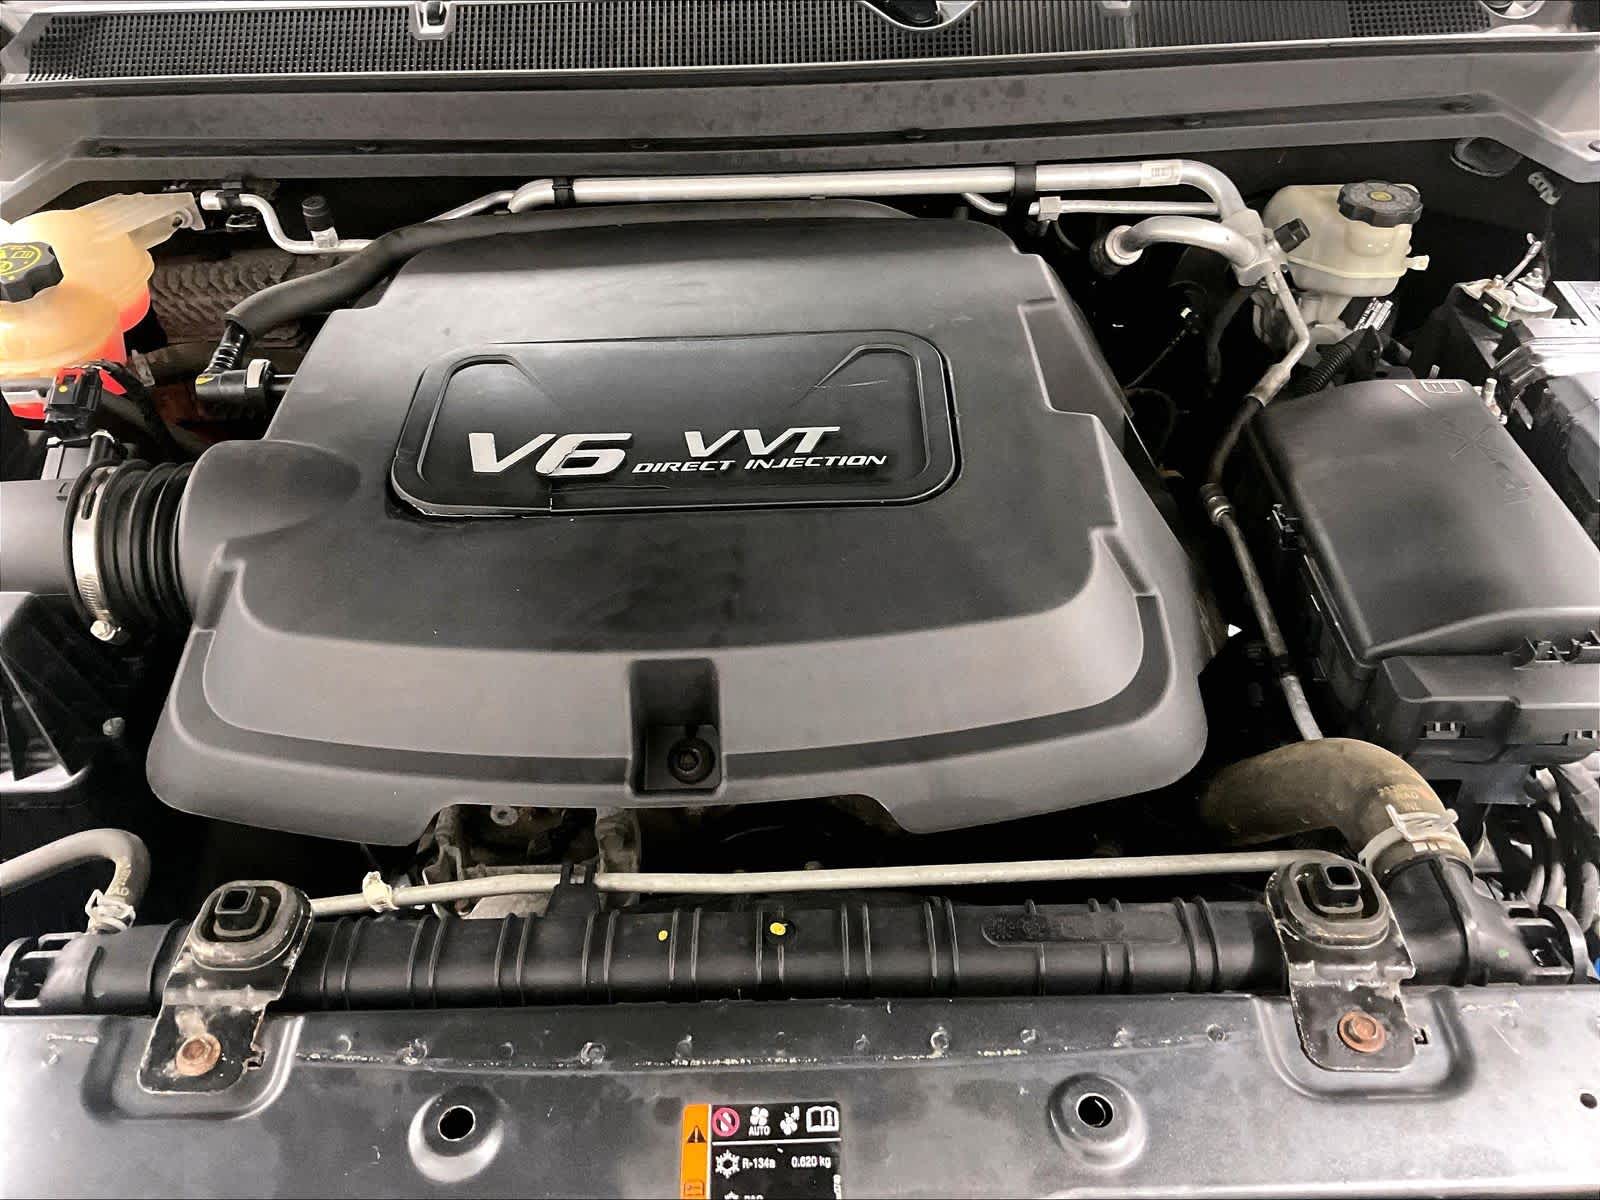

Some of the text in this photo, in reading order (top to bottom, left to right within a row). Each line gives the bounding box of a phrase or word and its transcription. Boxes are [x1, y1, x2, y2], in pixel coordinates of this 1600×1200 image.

[684, 426, 841, 458] VVT
[468, 432, 633, 477] V6
[631, 454, 888, 474] DIRECT INJECTION
[748, 1125, 771, 1137] AUTO
[742, 1156, 776, 1169] R-134a
[819, 1155, 832, 1169] kg
